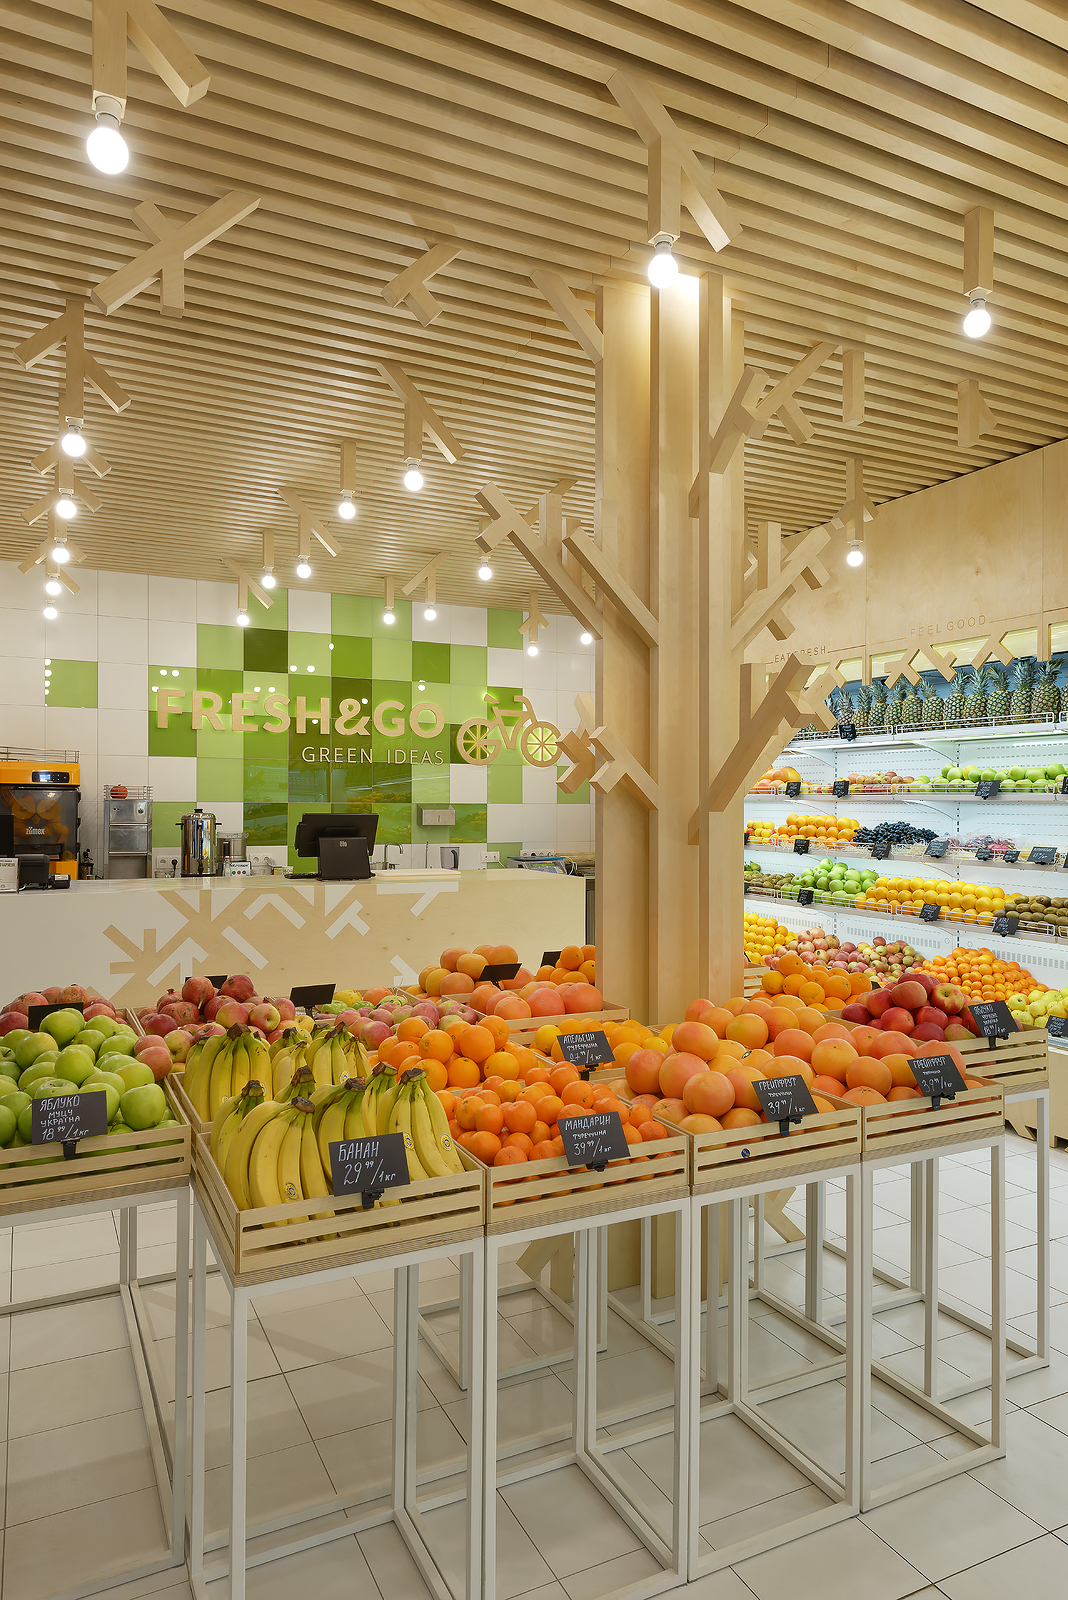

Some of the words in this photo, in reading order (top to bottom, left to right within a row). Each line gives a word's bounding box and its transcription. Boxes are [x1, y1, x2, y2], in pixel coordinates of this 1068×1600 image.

[911, 624, 941, 637] FEEL
[947, 615, 986, 631] GOOD
[775, 652, 791, 663] EAT
[157, 689, 445, 738] FRESH&GO
[302, 746, 373, 764] GREEN
[387, 749, 444, 765] IDEAS
[563, 1033, 595, 1044] АПЕЛЬСИН
[40, 1095, 80, 1112] ЯБЛУКО
[40, 1115, 81, 1128] УКРАЇНА
[48, 1109, 73, 1119] МУЦУ
[565, 1115, 611, 1131] МАНДАРИН
[338, 1141, 380, 1162] БАНАН
